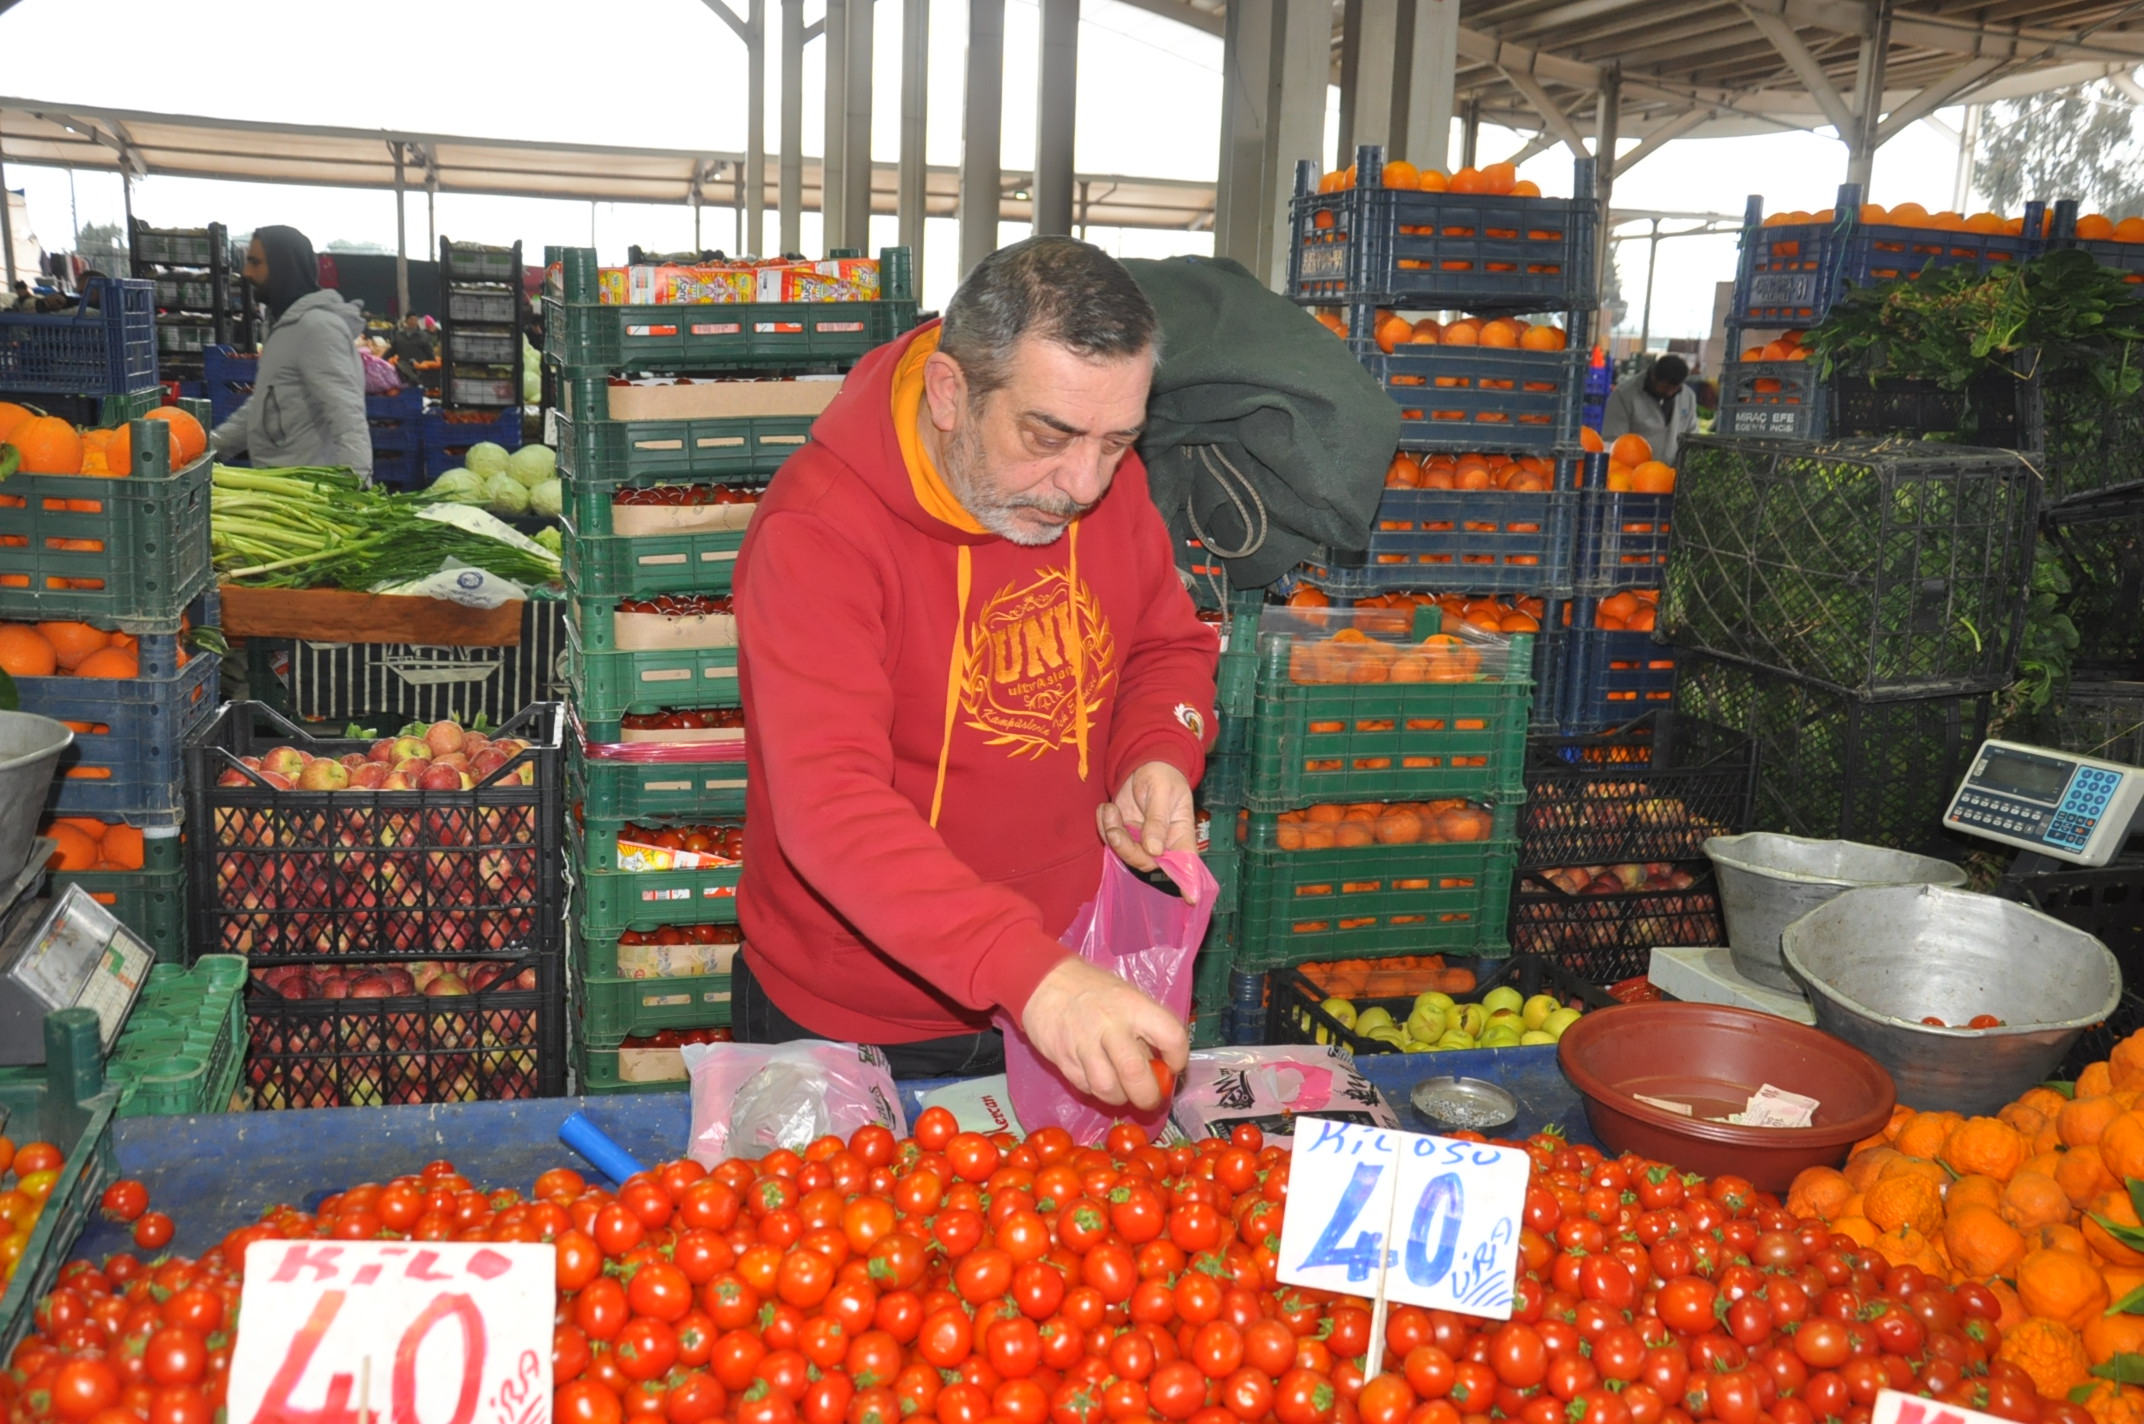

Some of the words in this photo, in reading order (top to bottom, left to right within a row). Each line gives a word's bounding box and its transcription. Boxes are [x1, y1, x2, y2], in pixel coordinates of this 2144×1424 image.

[1772, 412, 1795, 422] EFE
[1296, 1161, 1466, 1288] 40
[248, 1289, 489, 1424] 40
